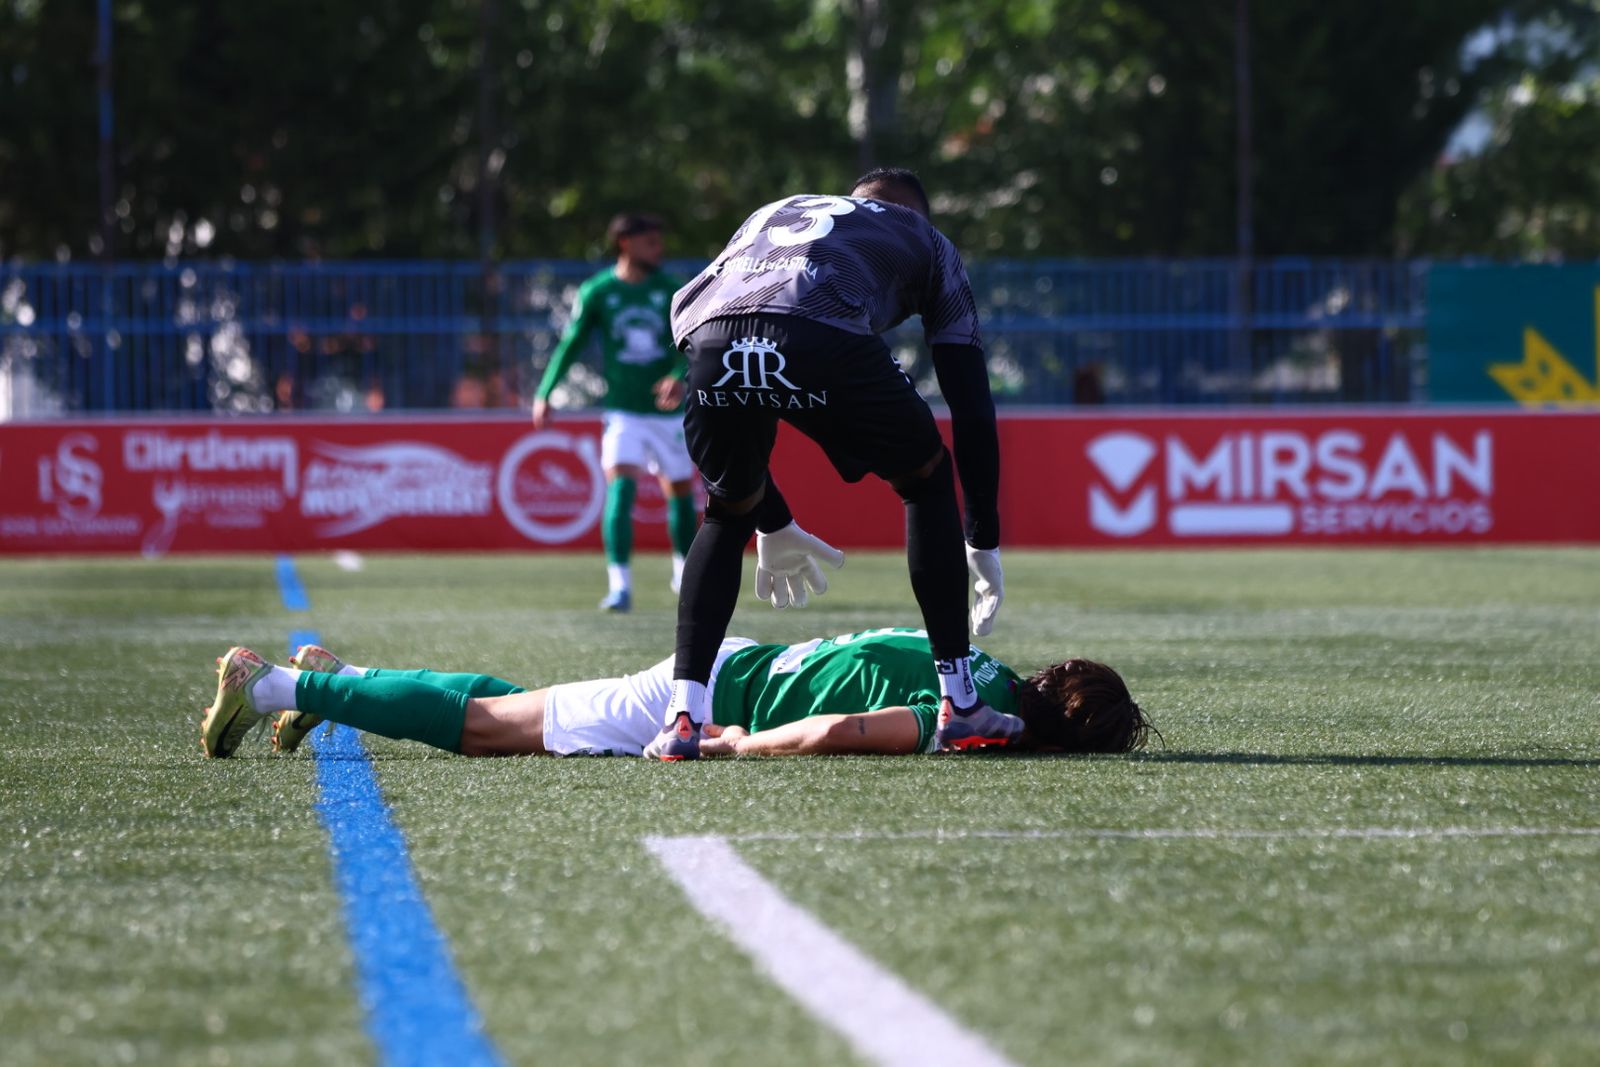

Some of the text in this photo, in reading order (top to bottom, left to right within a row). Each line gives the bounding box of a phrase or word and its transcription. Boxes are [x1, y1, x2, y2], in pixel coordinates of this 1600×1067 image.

[697, 389, 827, 409] REVISAN
[1165, 429, 1493, 501] MIRSAN
[1301, 504, 1492, 534] SERVICIOS
